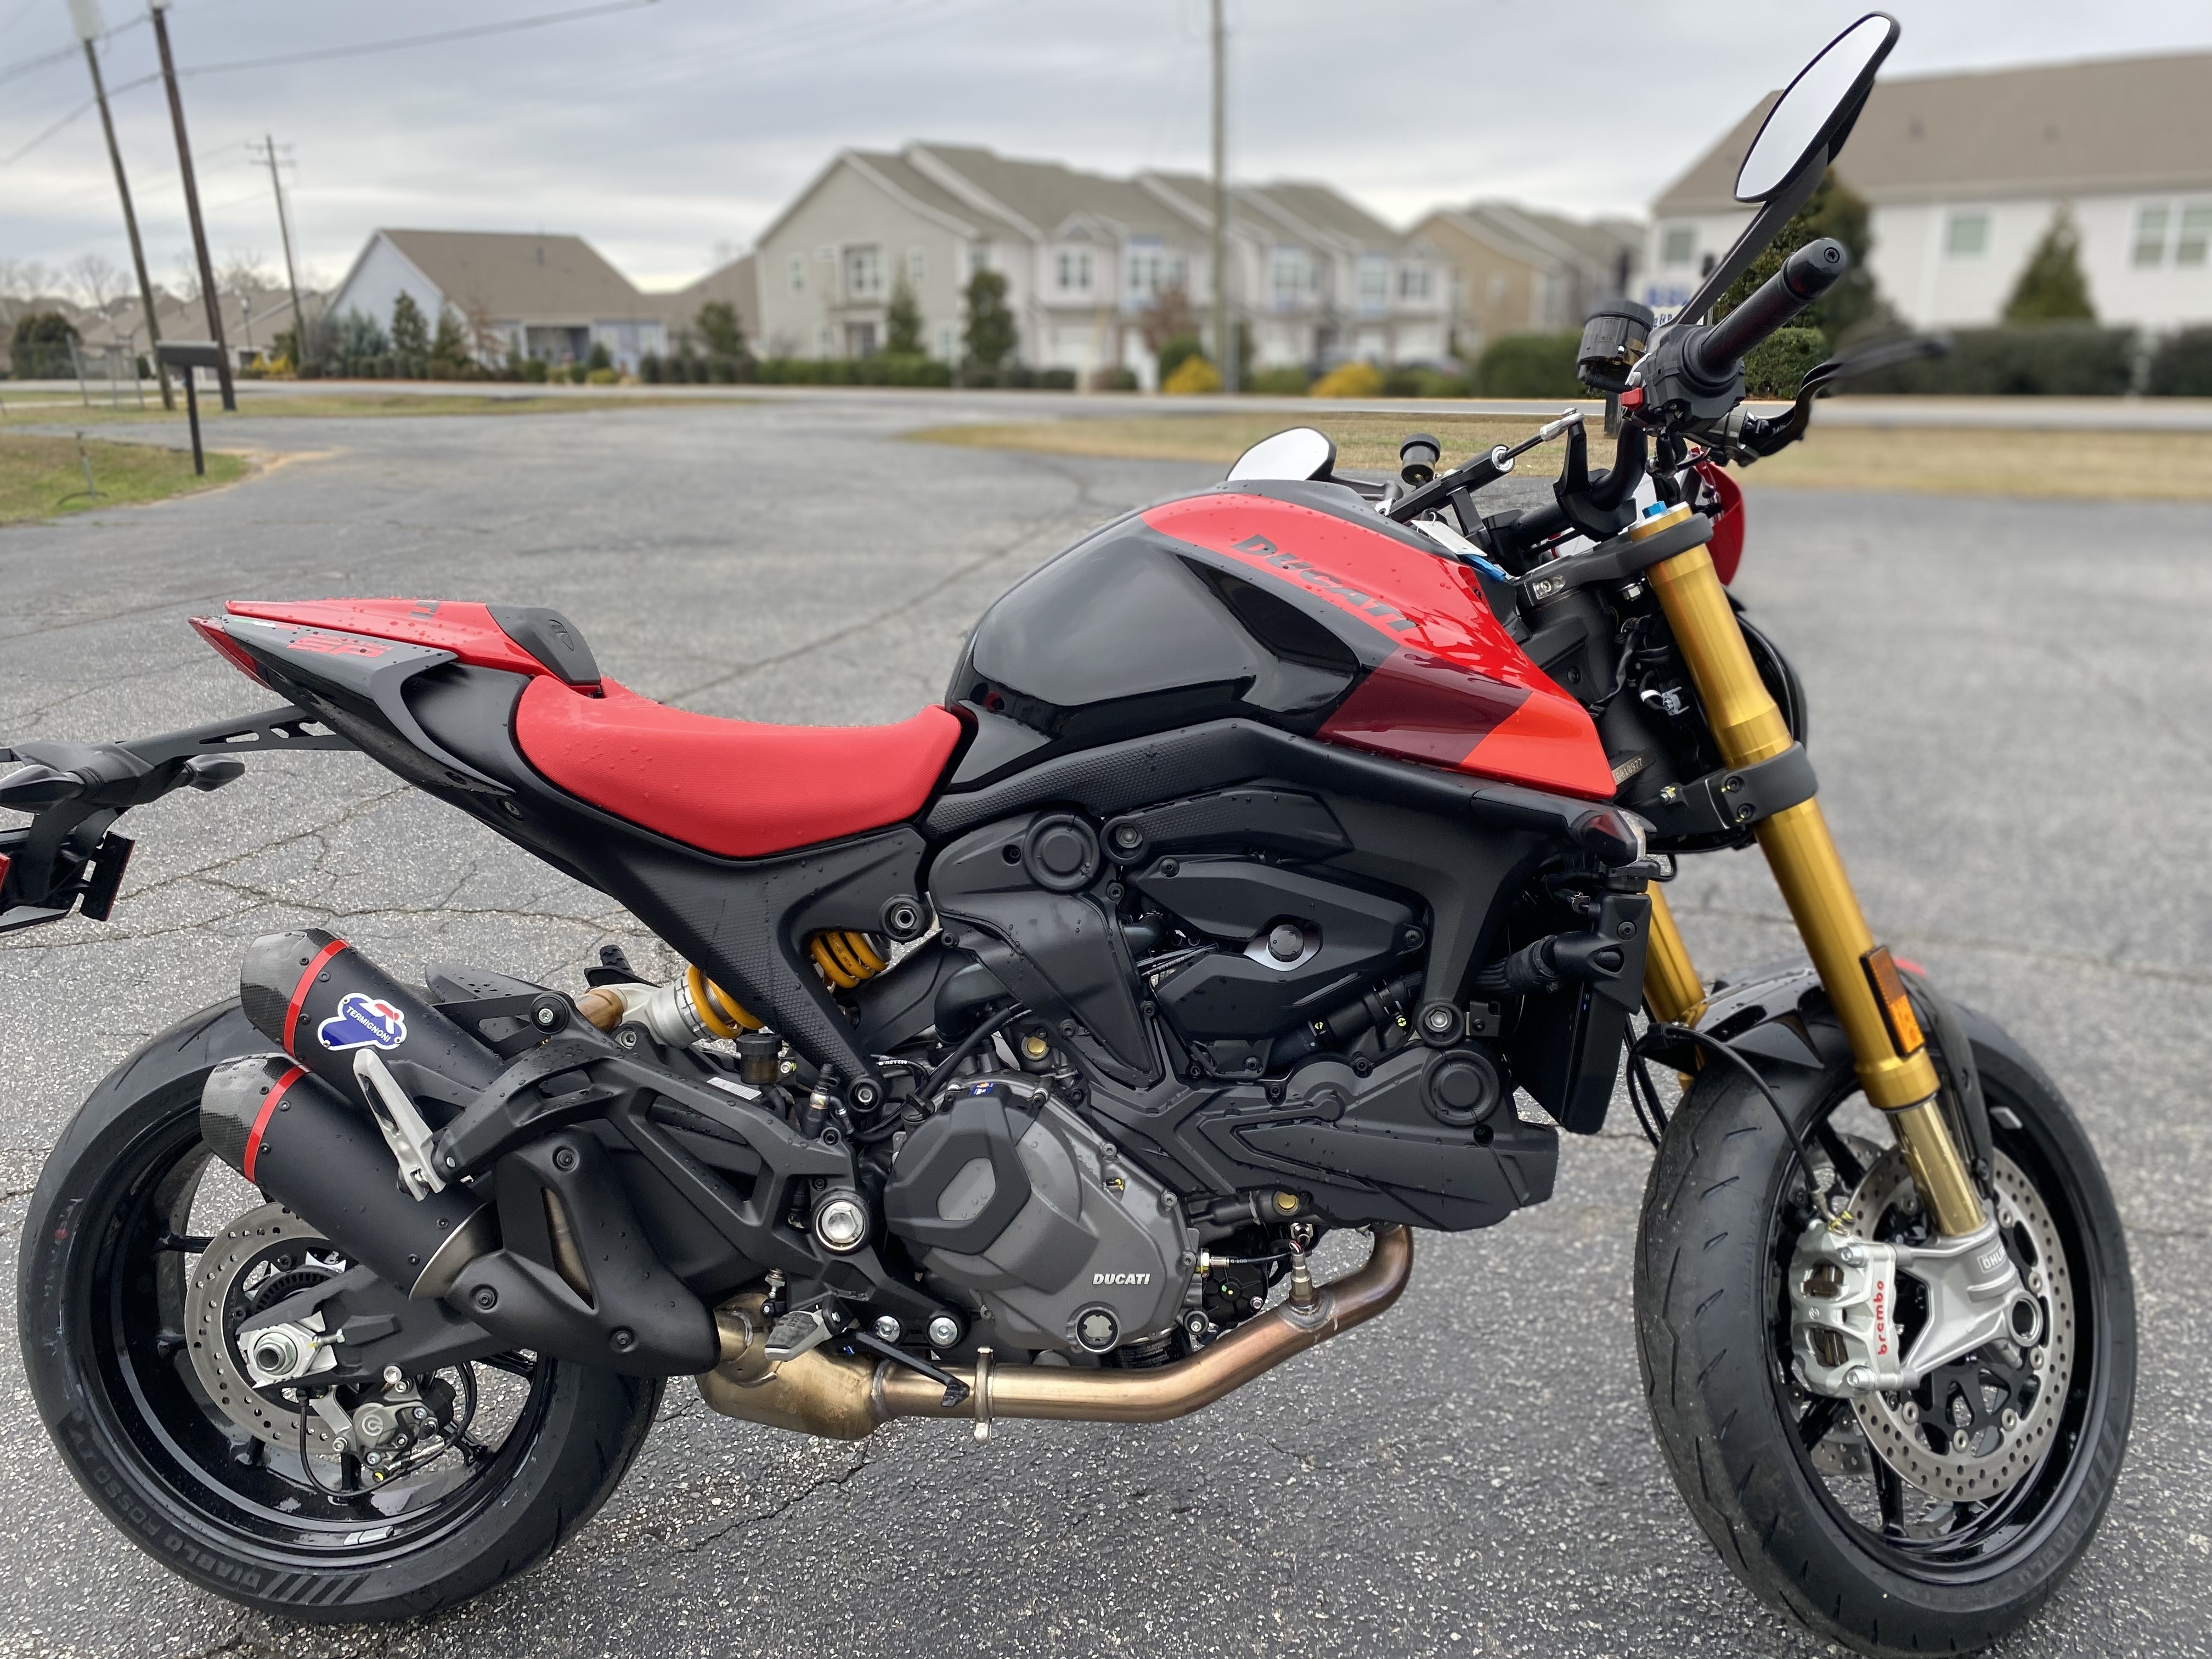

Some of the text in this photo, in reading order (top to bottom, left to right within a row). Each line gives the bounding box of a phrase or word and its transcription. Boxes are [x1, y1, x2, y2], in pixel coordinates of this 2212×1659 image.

[1230, 534, 1419, 632] DUCATI
[286, 633, 394, 658] SP
[346, 1006, 391, 1043] TERMIGNONI
[1092, 1273, 1150, 1285] DUCATI
[1982, 1246, 2006, 1269] ÖHLIN
[1873, 1280, 1888, 1356] brembo
[93, 1466, 161, 1536] ROSSO
[166, 1536, 261, 1589] DIABLO
